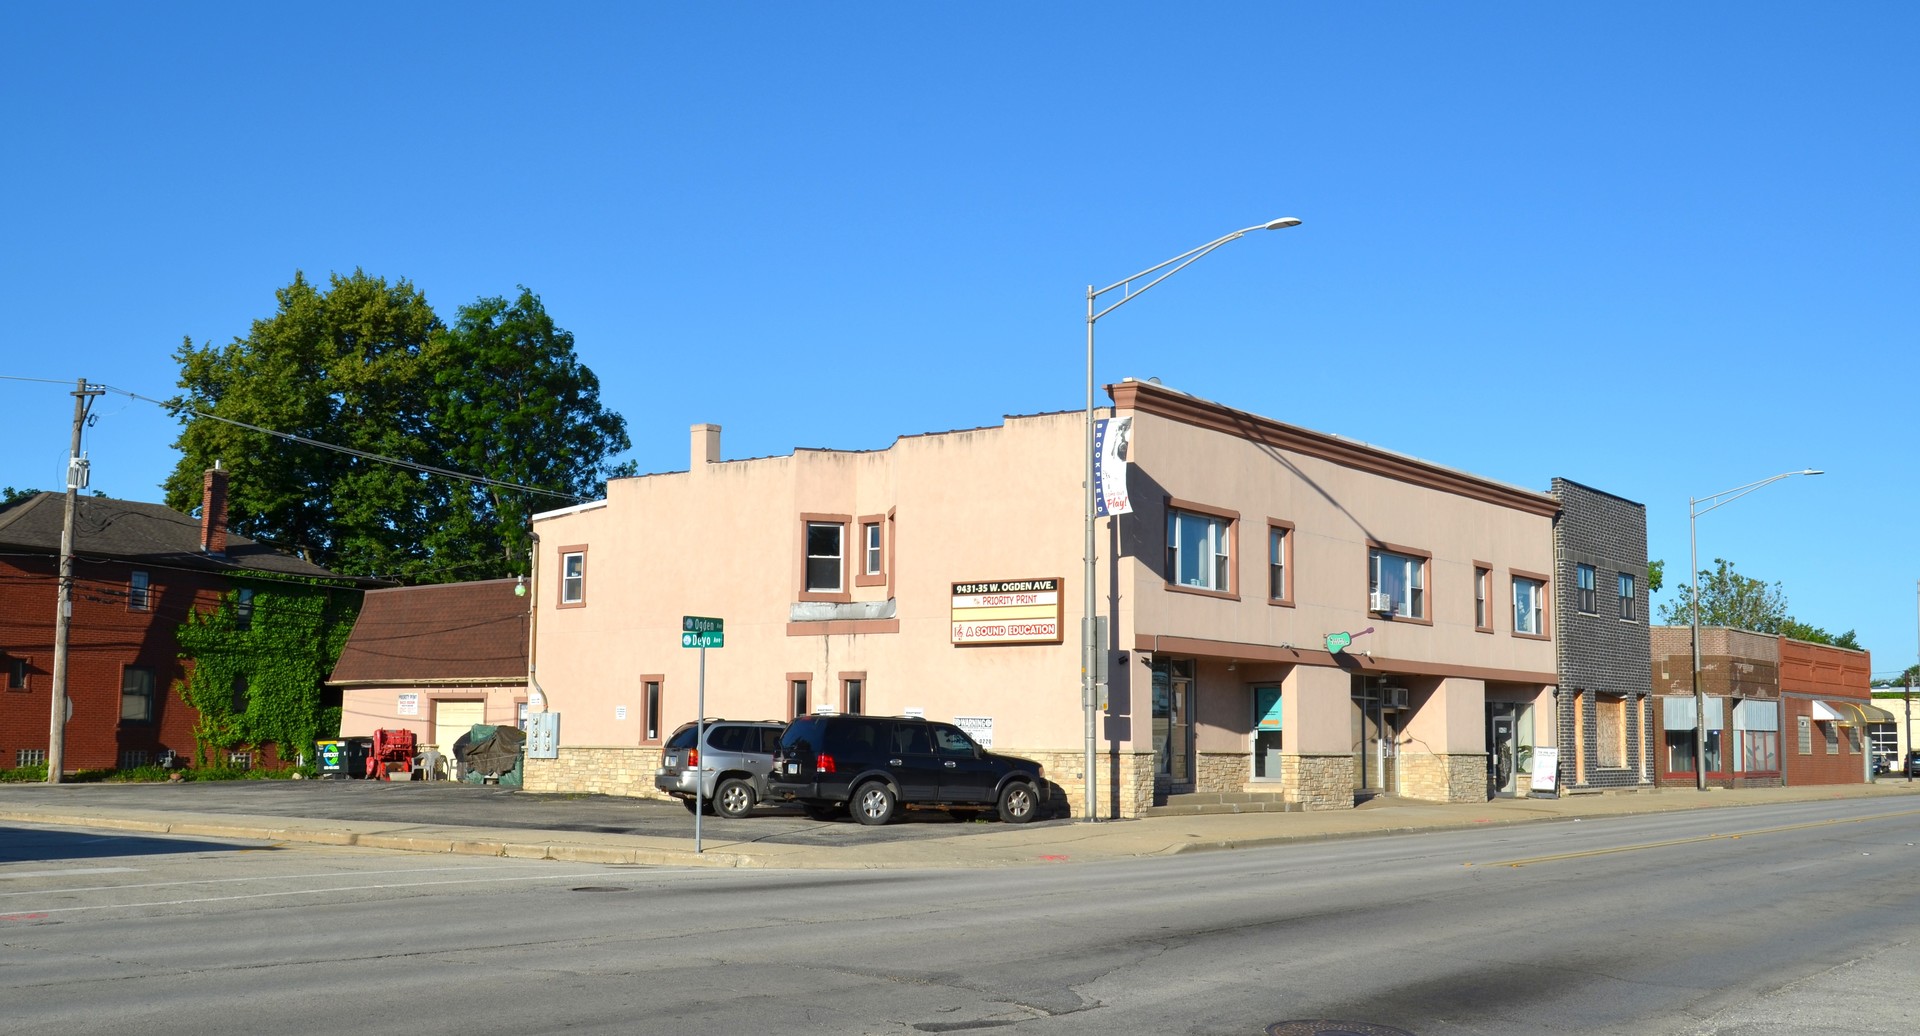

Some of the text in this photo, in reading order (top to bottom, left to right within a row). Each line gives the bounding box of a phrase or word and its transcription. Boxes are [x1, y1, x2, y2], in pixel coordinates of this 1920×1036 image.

[1095, 423, 1103, 513] BROOKFIELD
[1106, 496, 1129, 511] Play!
[956, 581, 1054, 594] 9431-35 W. OGDEN AVE.
[982, 594, 1038, 606] PRIORITY PRINT
[694, 618, 715, 632] Ogden
[966, 623, 1056, 637] A SOUND EDUCATION
[692, 634, 711, 648] Deyo
